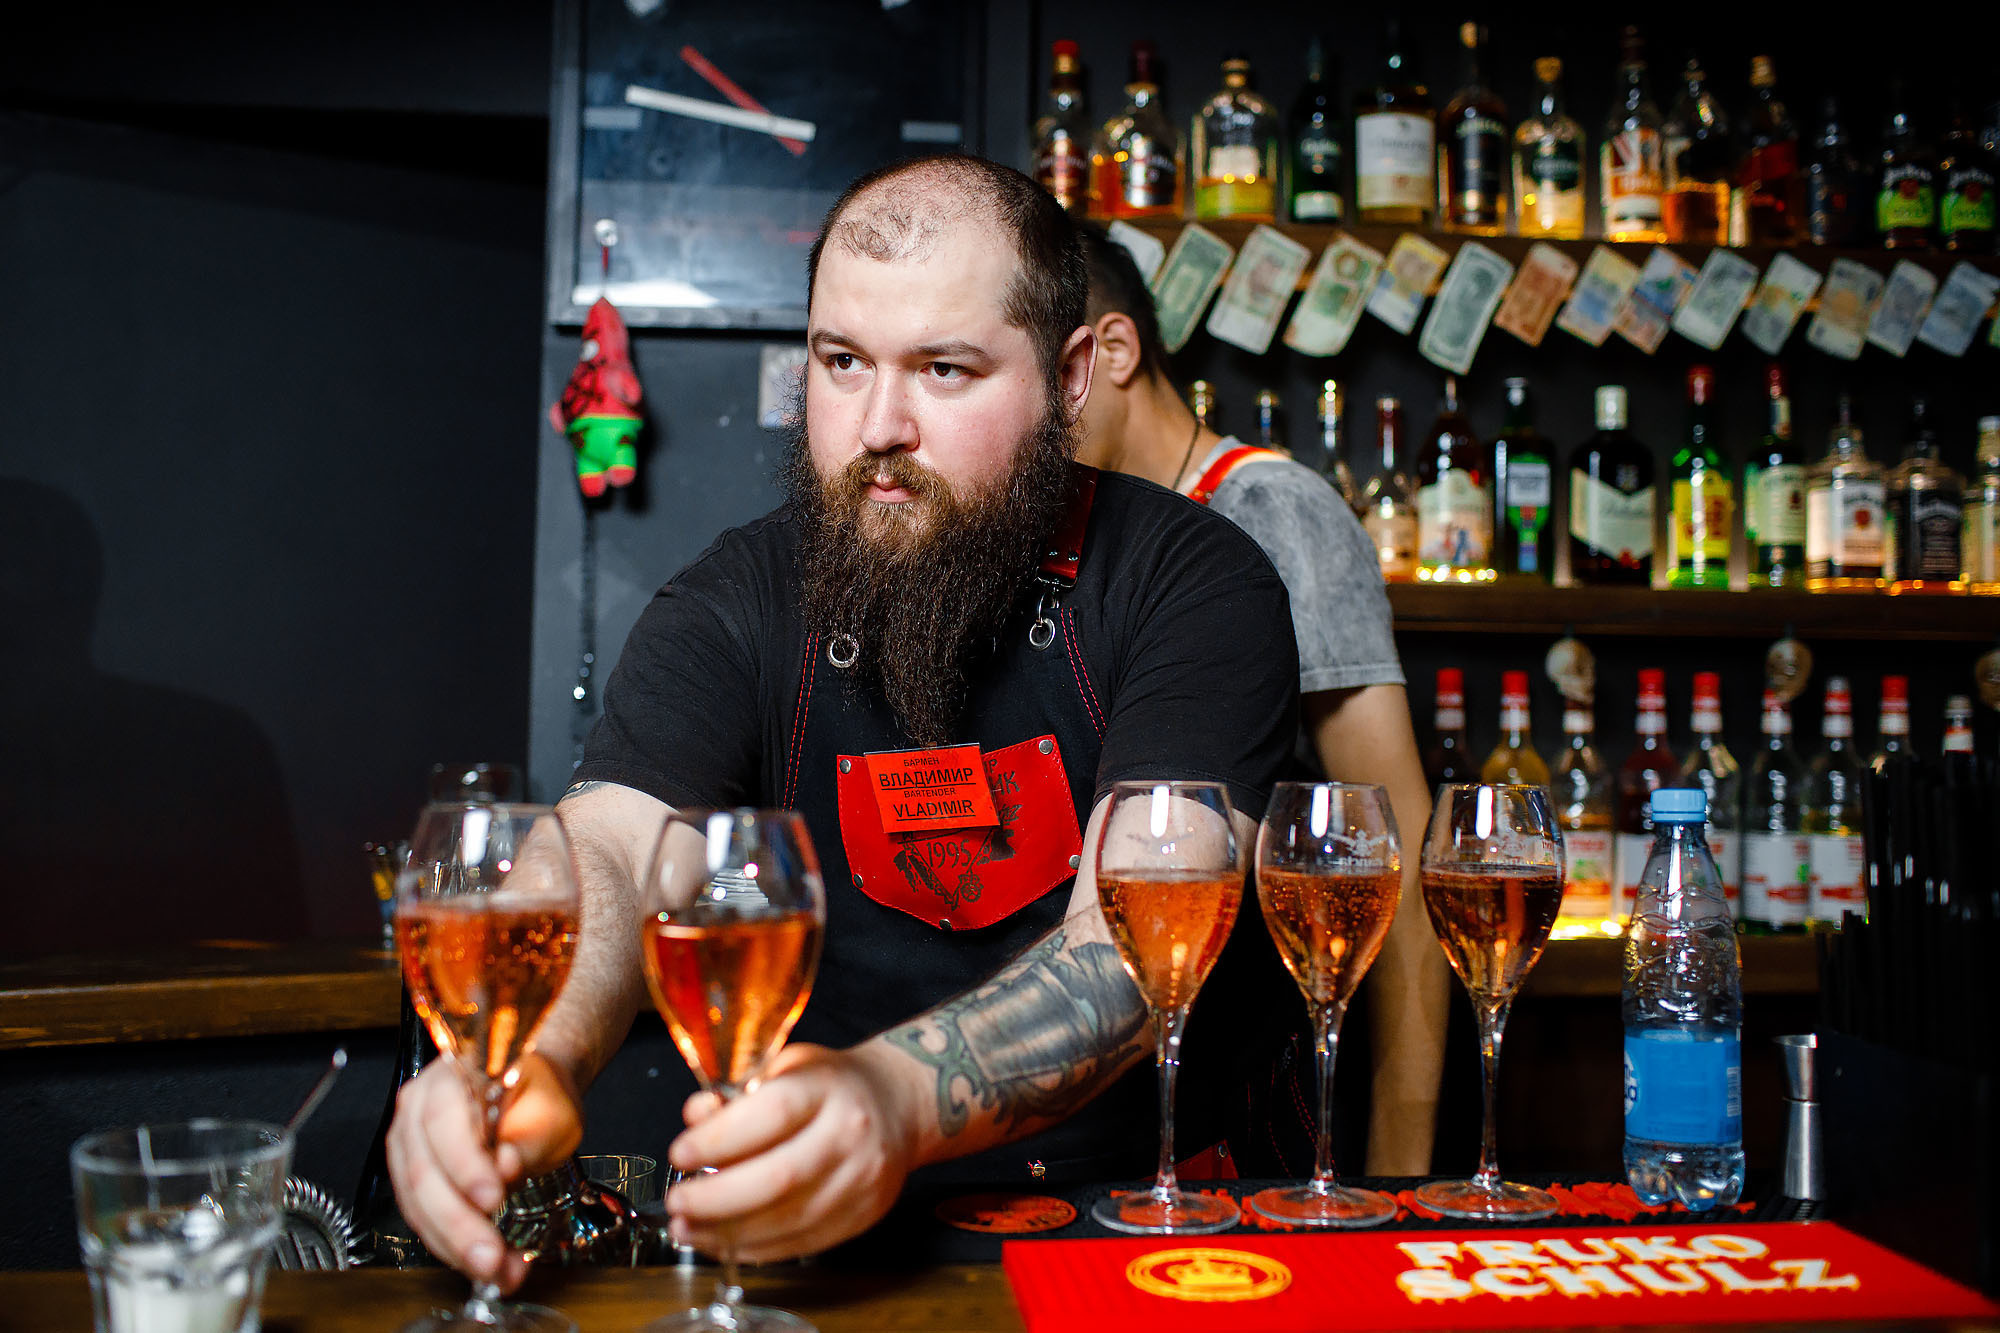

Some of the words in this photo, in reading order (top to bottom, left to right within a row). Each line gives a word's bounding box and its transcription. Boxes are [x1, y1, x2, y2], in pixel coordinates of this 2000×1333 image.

[903, 756, 940, 767] БАРМЕН
[879, 767, 973, 788] ВЛАДИМИР
[904, 787, 956, 799] BARTENDER
[894, 799, 975, 818] VLADIMIR
[926, 839, 972, 869] 1995
[1397, 1233, 1770, 1270] FRUKO
[1397, 1257, 1860, 1304] SCHULZ
